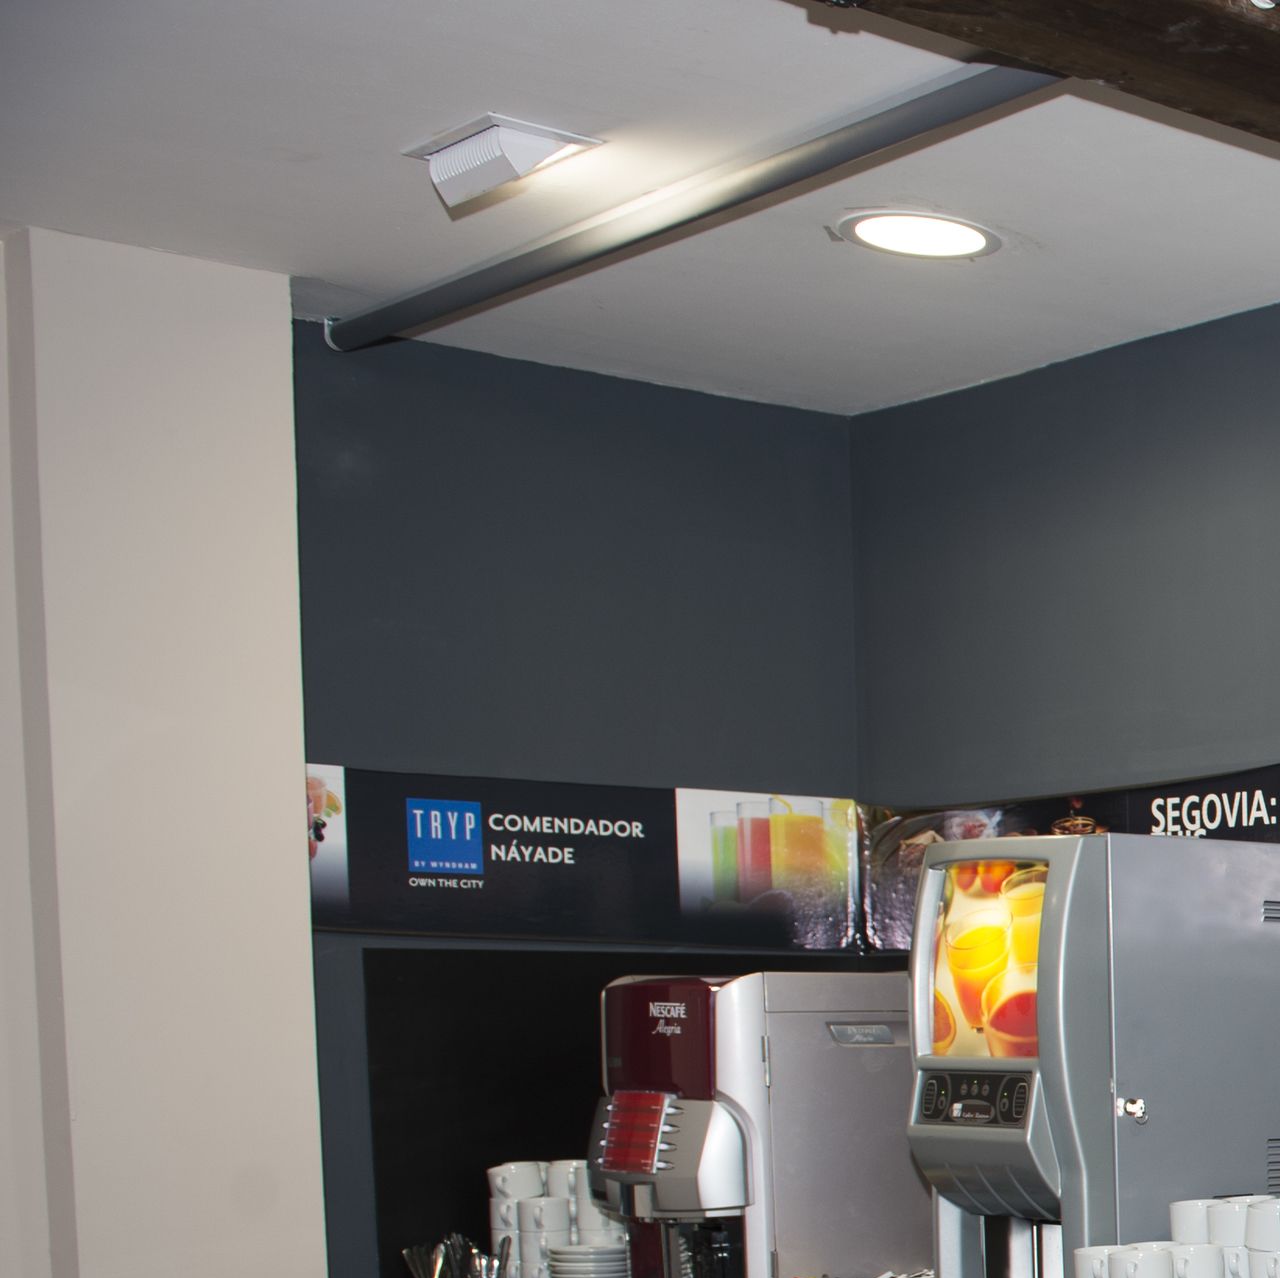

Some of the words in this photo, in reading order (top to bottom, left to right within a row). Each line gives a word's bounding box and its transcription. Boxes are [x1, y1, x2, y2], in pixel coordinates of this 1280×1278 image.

[1151, 789, 1277, 833] SEGOVIA:
[413, 809, 476, 841] TRYP
[488, 813, 645, 838] COMENDADOR
[490, 840, 576, 864] NÁYADE
[430, 861, 478, 870] WYNDHAM
[408, 877, 436, 888] OWN
[437, 878, 459, 888] THE
[460, 879, 484, 889] CITY
[649, 1002, 687, 1018] NESCAFÉ
[652, 1019, 682, 1036] Alegria
